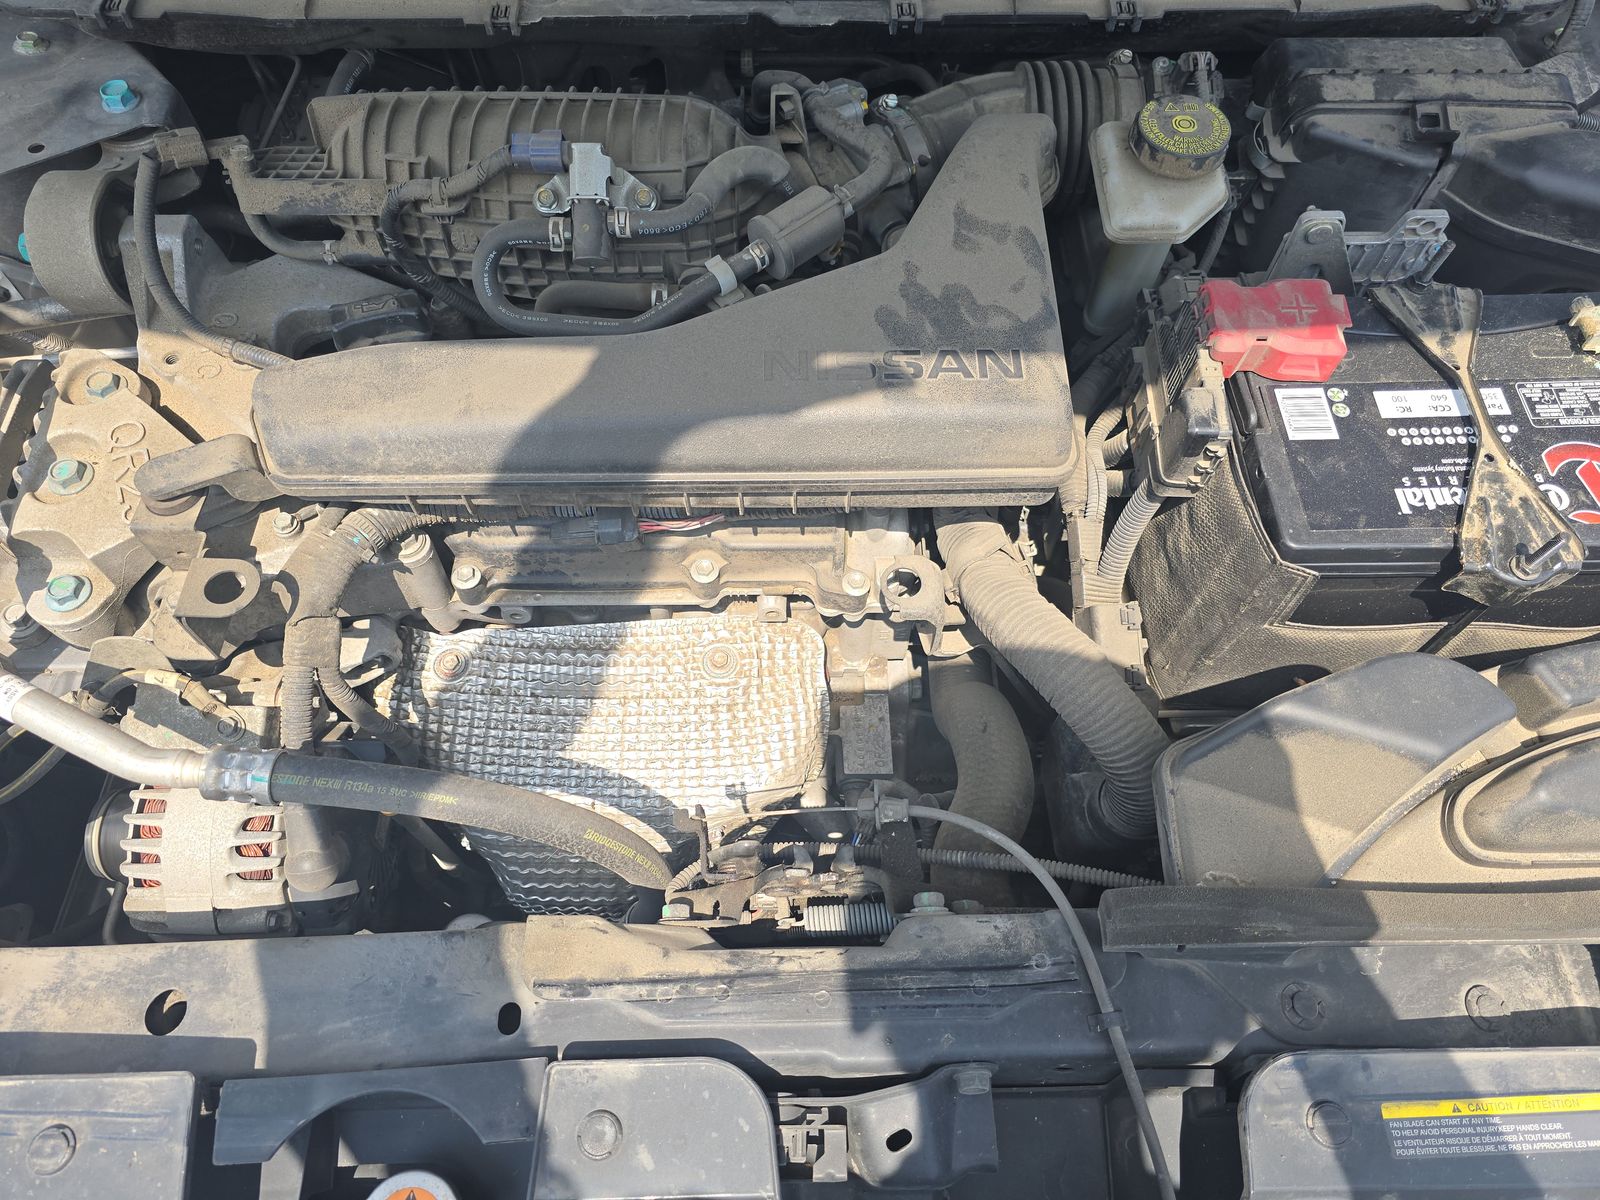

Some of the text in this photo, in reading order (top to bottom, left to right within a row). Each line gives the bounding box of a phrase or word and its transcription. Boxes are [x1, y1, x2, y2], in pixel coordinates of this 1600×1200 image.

[763, 349, 1025, 381] NISSAN
[1395, 405, 1412, 413] RC:
[583, 827, 637, 859] BRIDGESTONE
[1467, 1101, 1513, 1112] CAUTION
[1524, 1098, 1580, 1110] ATTENTION
[1389, 1120, 1402, 1128] FAN
[1403, 1119, 1425, 1128] BLADE
[1425, 1119, 1440, 1127] CAN
[1441, 1118, 1461, 1126] START
[1471, 1117, 1484, 1125] ANY
[1420, 1128, 1440, 1136] AVOID
[1440, 1127, 1476, 1135] PERSONAL
[1499, 1124, 1515, 1132] KEEP
[1516, 1123, 1540, 1131] HANDS
[1540, 1122, 1564, 1130] CLEAR.
[1403, 1138, 1445, 1147] VENTILATEUR
[1446, 1137, 1471, 1145] RISQUE
[1482, 1134, 1518, 1143] DÉMARRER
[1524, 1133, 1542, 1141] TOUT
[1541, 1132, 1573, 1140] MOMENT.
[1396, 1148, 1416, 1156] POUR
[1416, 1146, 1439, 1155] ÉVITER
[1439, 1146, 1461, 1154] TOUTE
[1498, 1144, 1508, 1152] NE
[1508, 1143, 1522, 1151] PAS
[1522, 1143, 1533, 1151] EN
[1533, 1141, 1574, 1150] APPROCHER
[1574, 1140, 1587, 1148] LES
